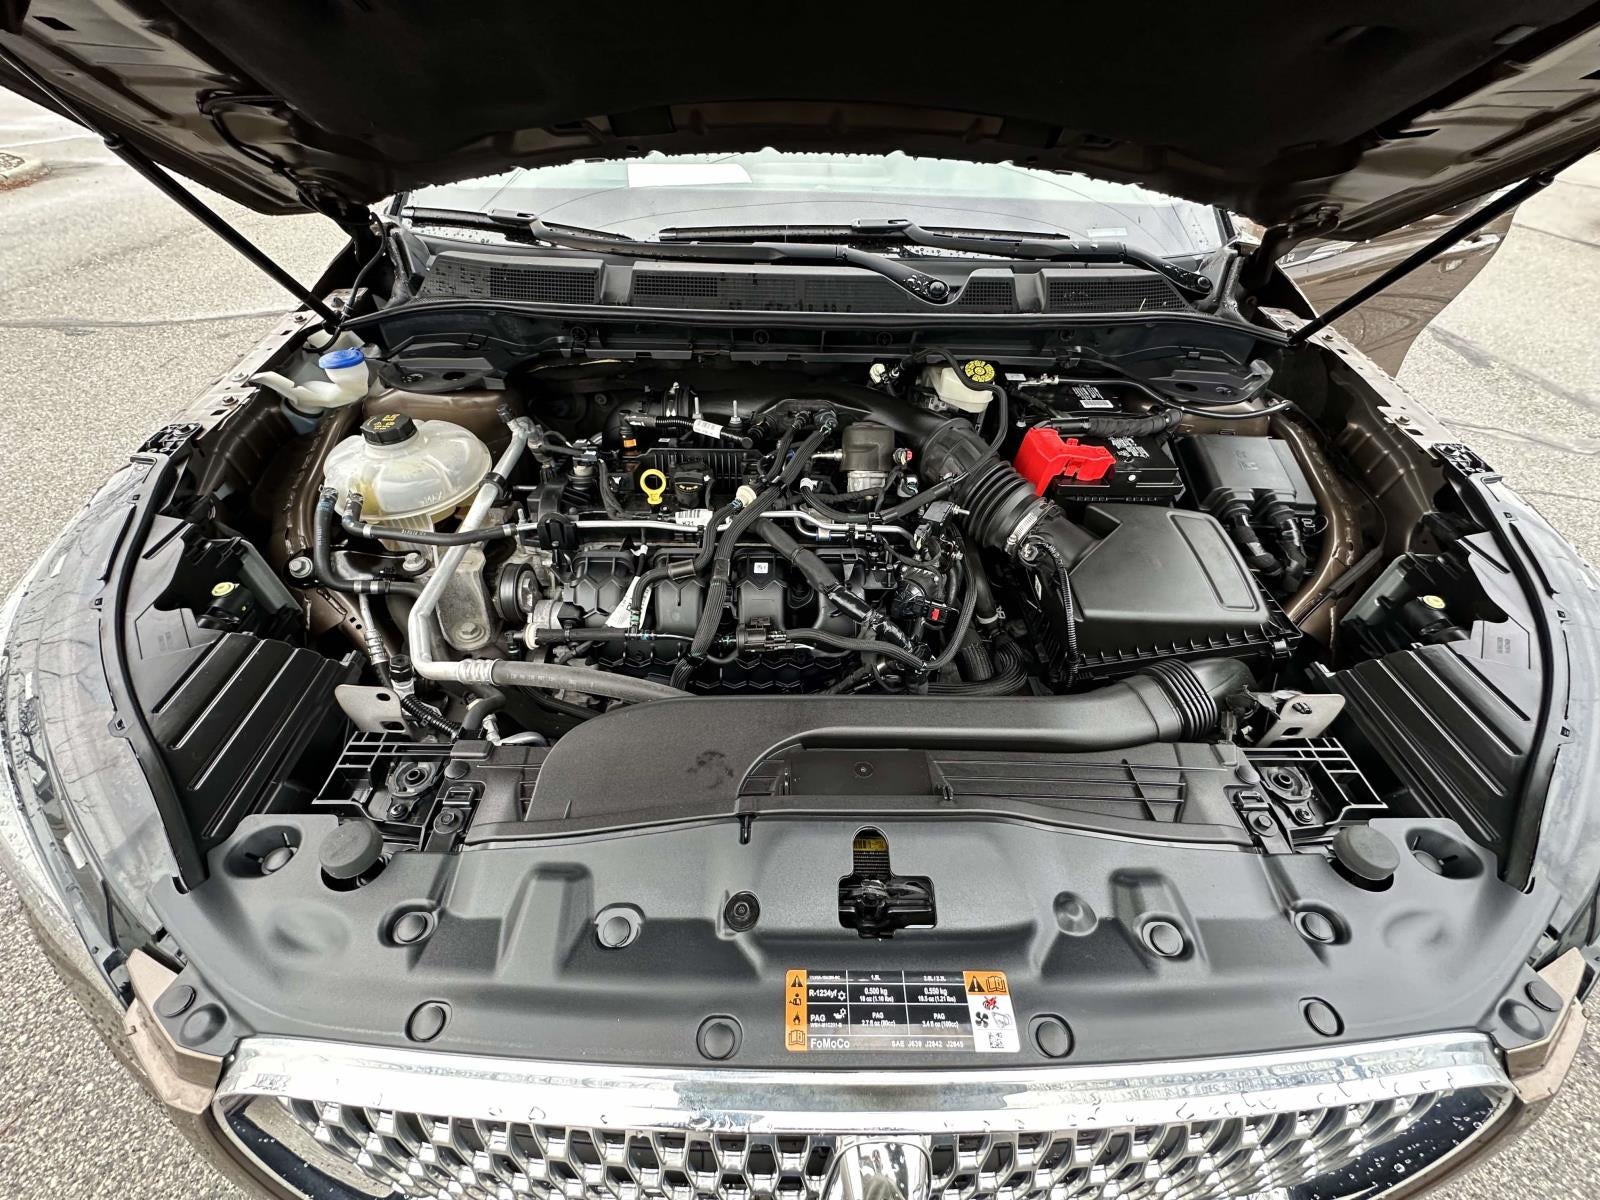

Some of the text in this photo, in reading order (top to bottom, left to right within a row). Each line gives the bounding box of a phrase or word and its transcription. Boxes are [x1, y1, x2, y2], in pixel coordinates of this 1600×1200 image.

[808, 989, 838, 998] R-1234yf
[864, 987, 888, 996] 0.500 kg
[923, 987, 948, 996] 0.550 kg
[810, 1014, 826, 1022] PAG
[872, 1011, 884, 1019] PAG
[810, 1038, 850, 1049] FoMoCo
